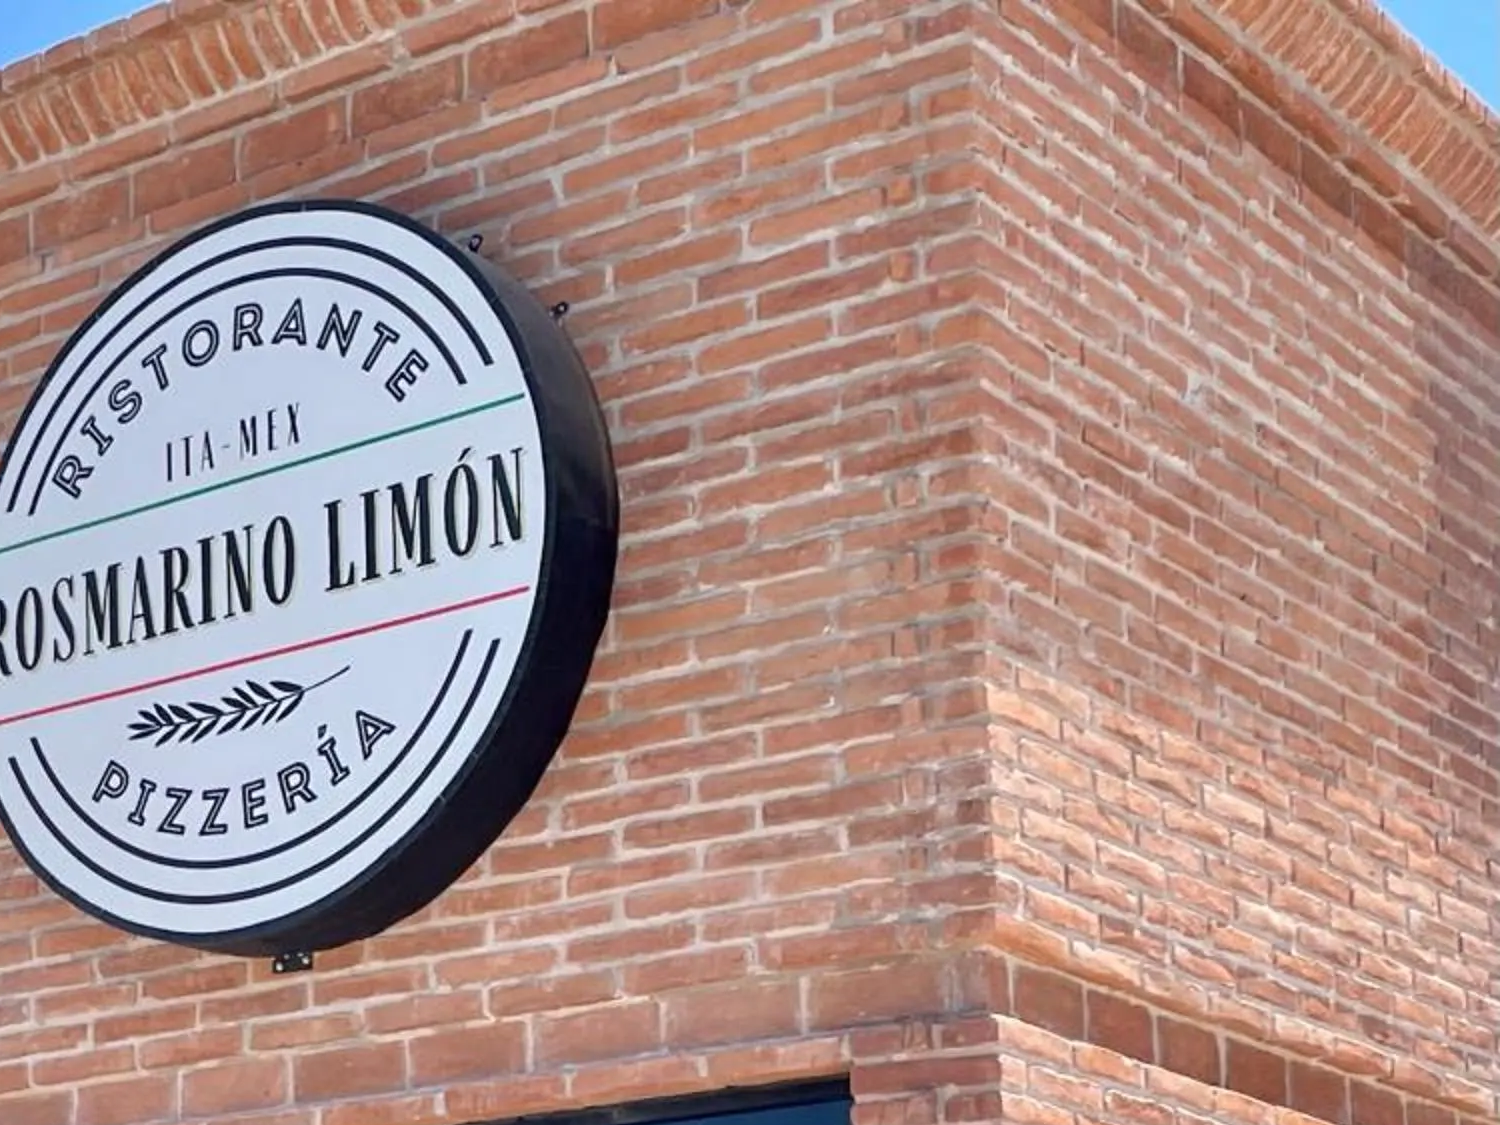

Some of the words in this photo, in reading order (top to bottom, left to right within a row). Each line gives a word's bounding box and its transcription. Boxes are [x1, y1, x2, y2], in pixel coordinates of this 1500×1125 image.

[53, 298, 429, 499] RISTORANTE
[166, 402, 302, 482] ITA-MEX
[325, 447, 525, 592] LIMÓN
[93, 708, 395, 836] PIZZERÍA
